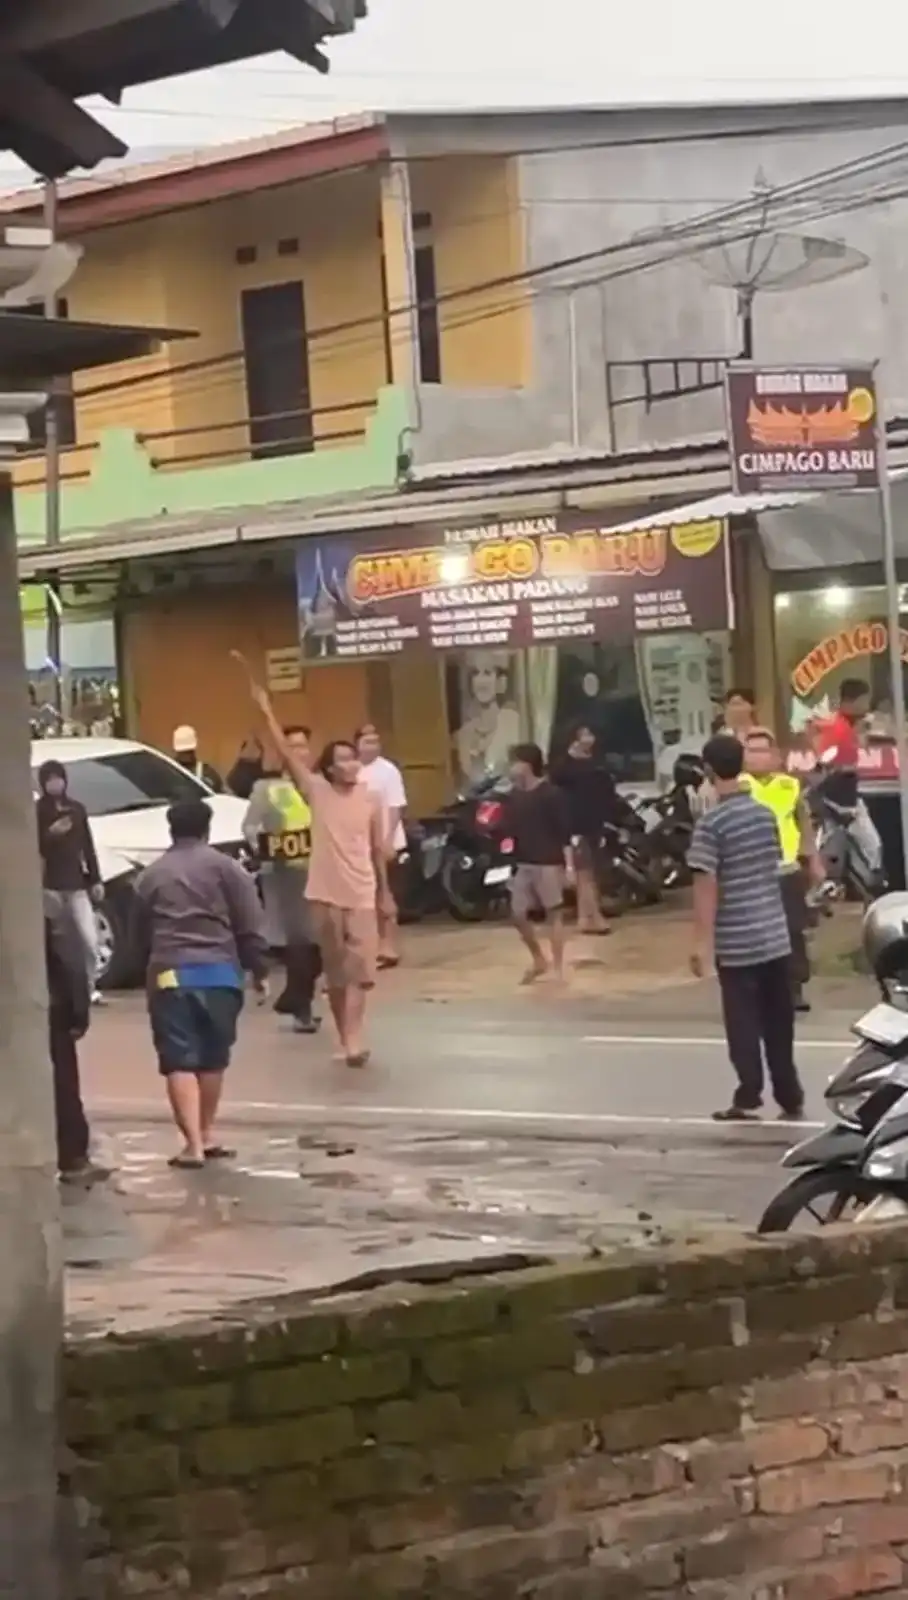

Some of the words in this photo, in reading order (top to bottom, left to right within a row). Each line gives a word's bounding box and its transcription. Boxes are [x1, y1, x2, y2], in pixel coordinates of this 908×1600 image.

[738, 451, 824, 473] CIMPAGO
[827, 449, 876, 471] BARU
[541, 530, 667, 576] BARU
[421, 583, 510, 608] MASAKAN
[513, 576, 589, 600] PADANG
